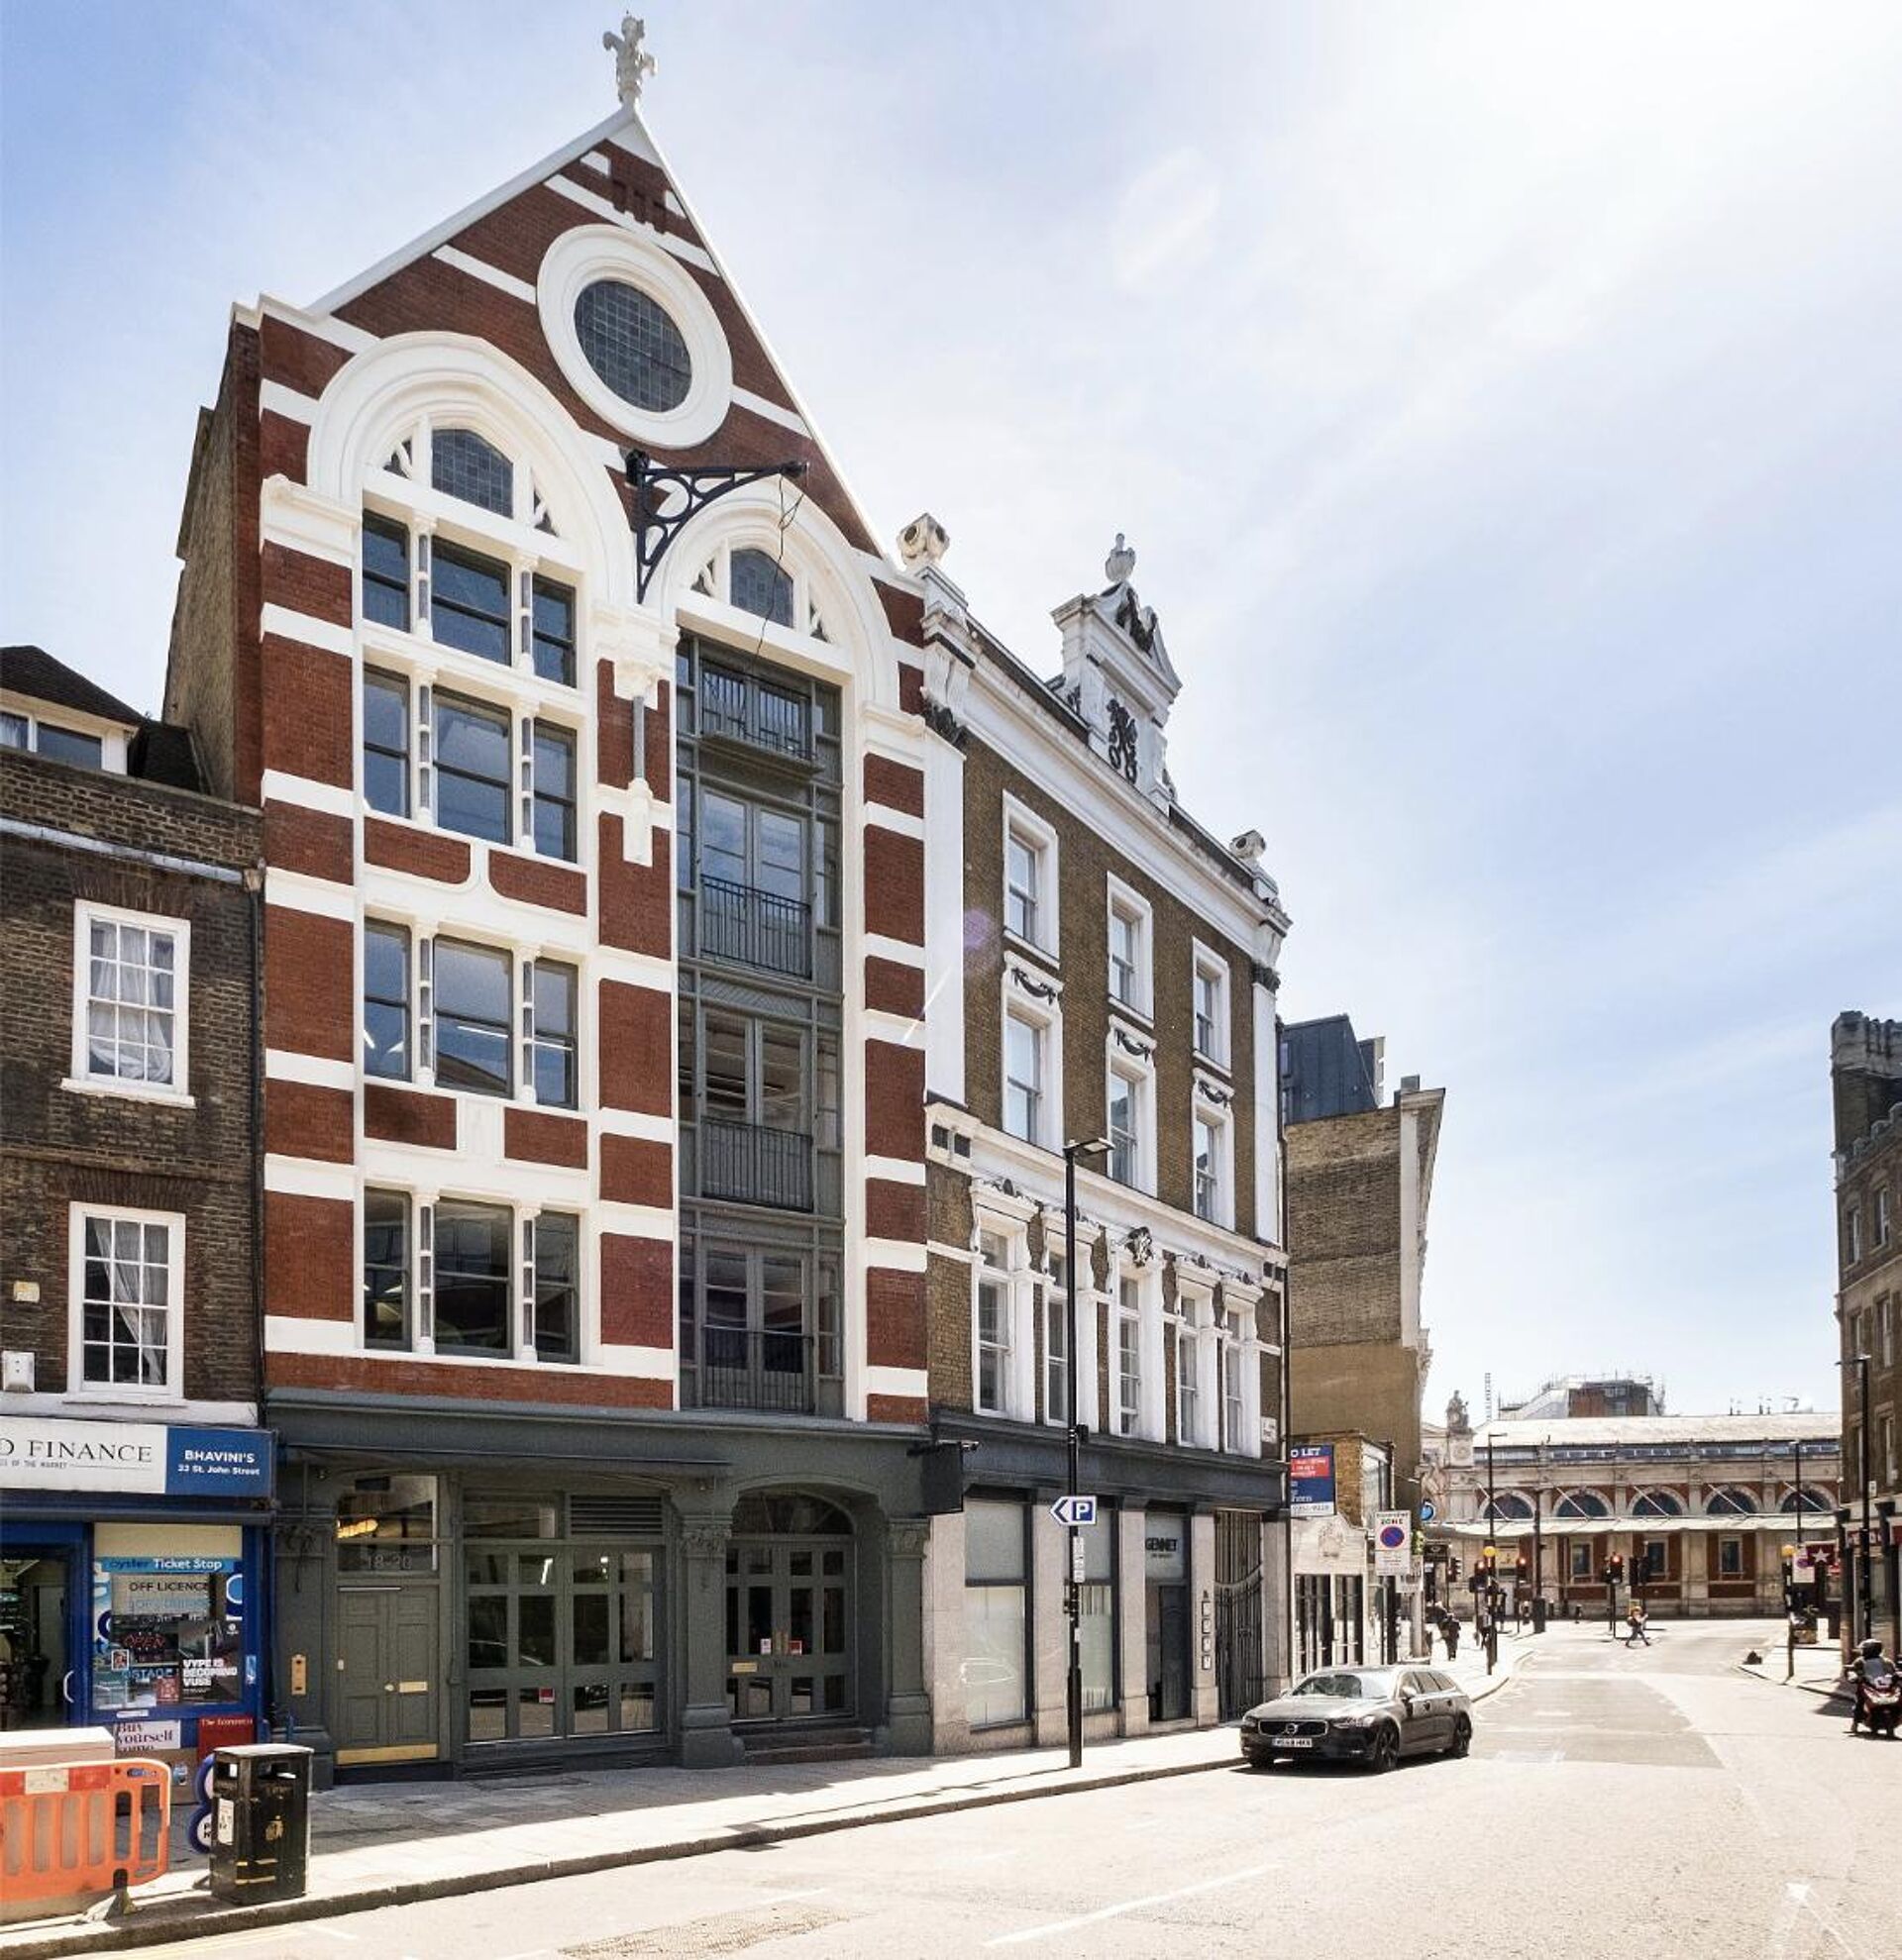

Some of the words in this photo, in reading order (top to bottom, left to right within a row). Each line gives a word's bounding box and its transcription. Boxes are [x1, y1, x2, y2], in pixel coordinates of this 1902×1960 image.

[27, 1439, 152, 1463] FINANCE
[184, 1449, 255, 1464] BHAVINI'S
[1302, 1448, 1321, 1457] LET
[207, 1466, 230, 1475] John
[232, 1467, 260, 1476] Street
[1075, 1502, 1091, 1520] P
[153, 1558, 191, 1570] Ticket
[193, 1559, 223, 1572] Stop
[129, 1582, 155, 1593] OFF
[124, 1634, 165, 1650] OPEN
[182, 1659, 211, 1668] VYPE
[212, 1658, 224, 1668] IS
[182, 1666, 238, 1678] BECOMING
[182, 1677, 212, 1687] VUSE
[117, 1729, 173, 1745] yourself
